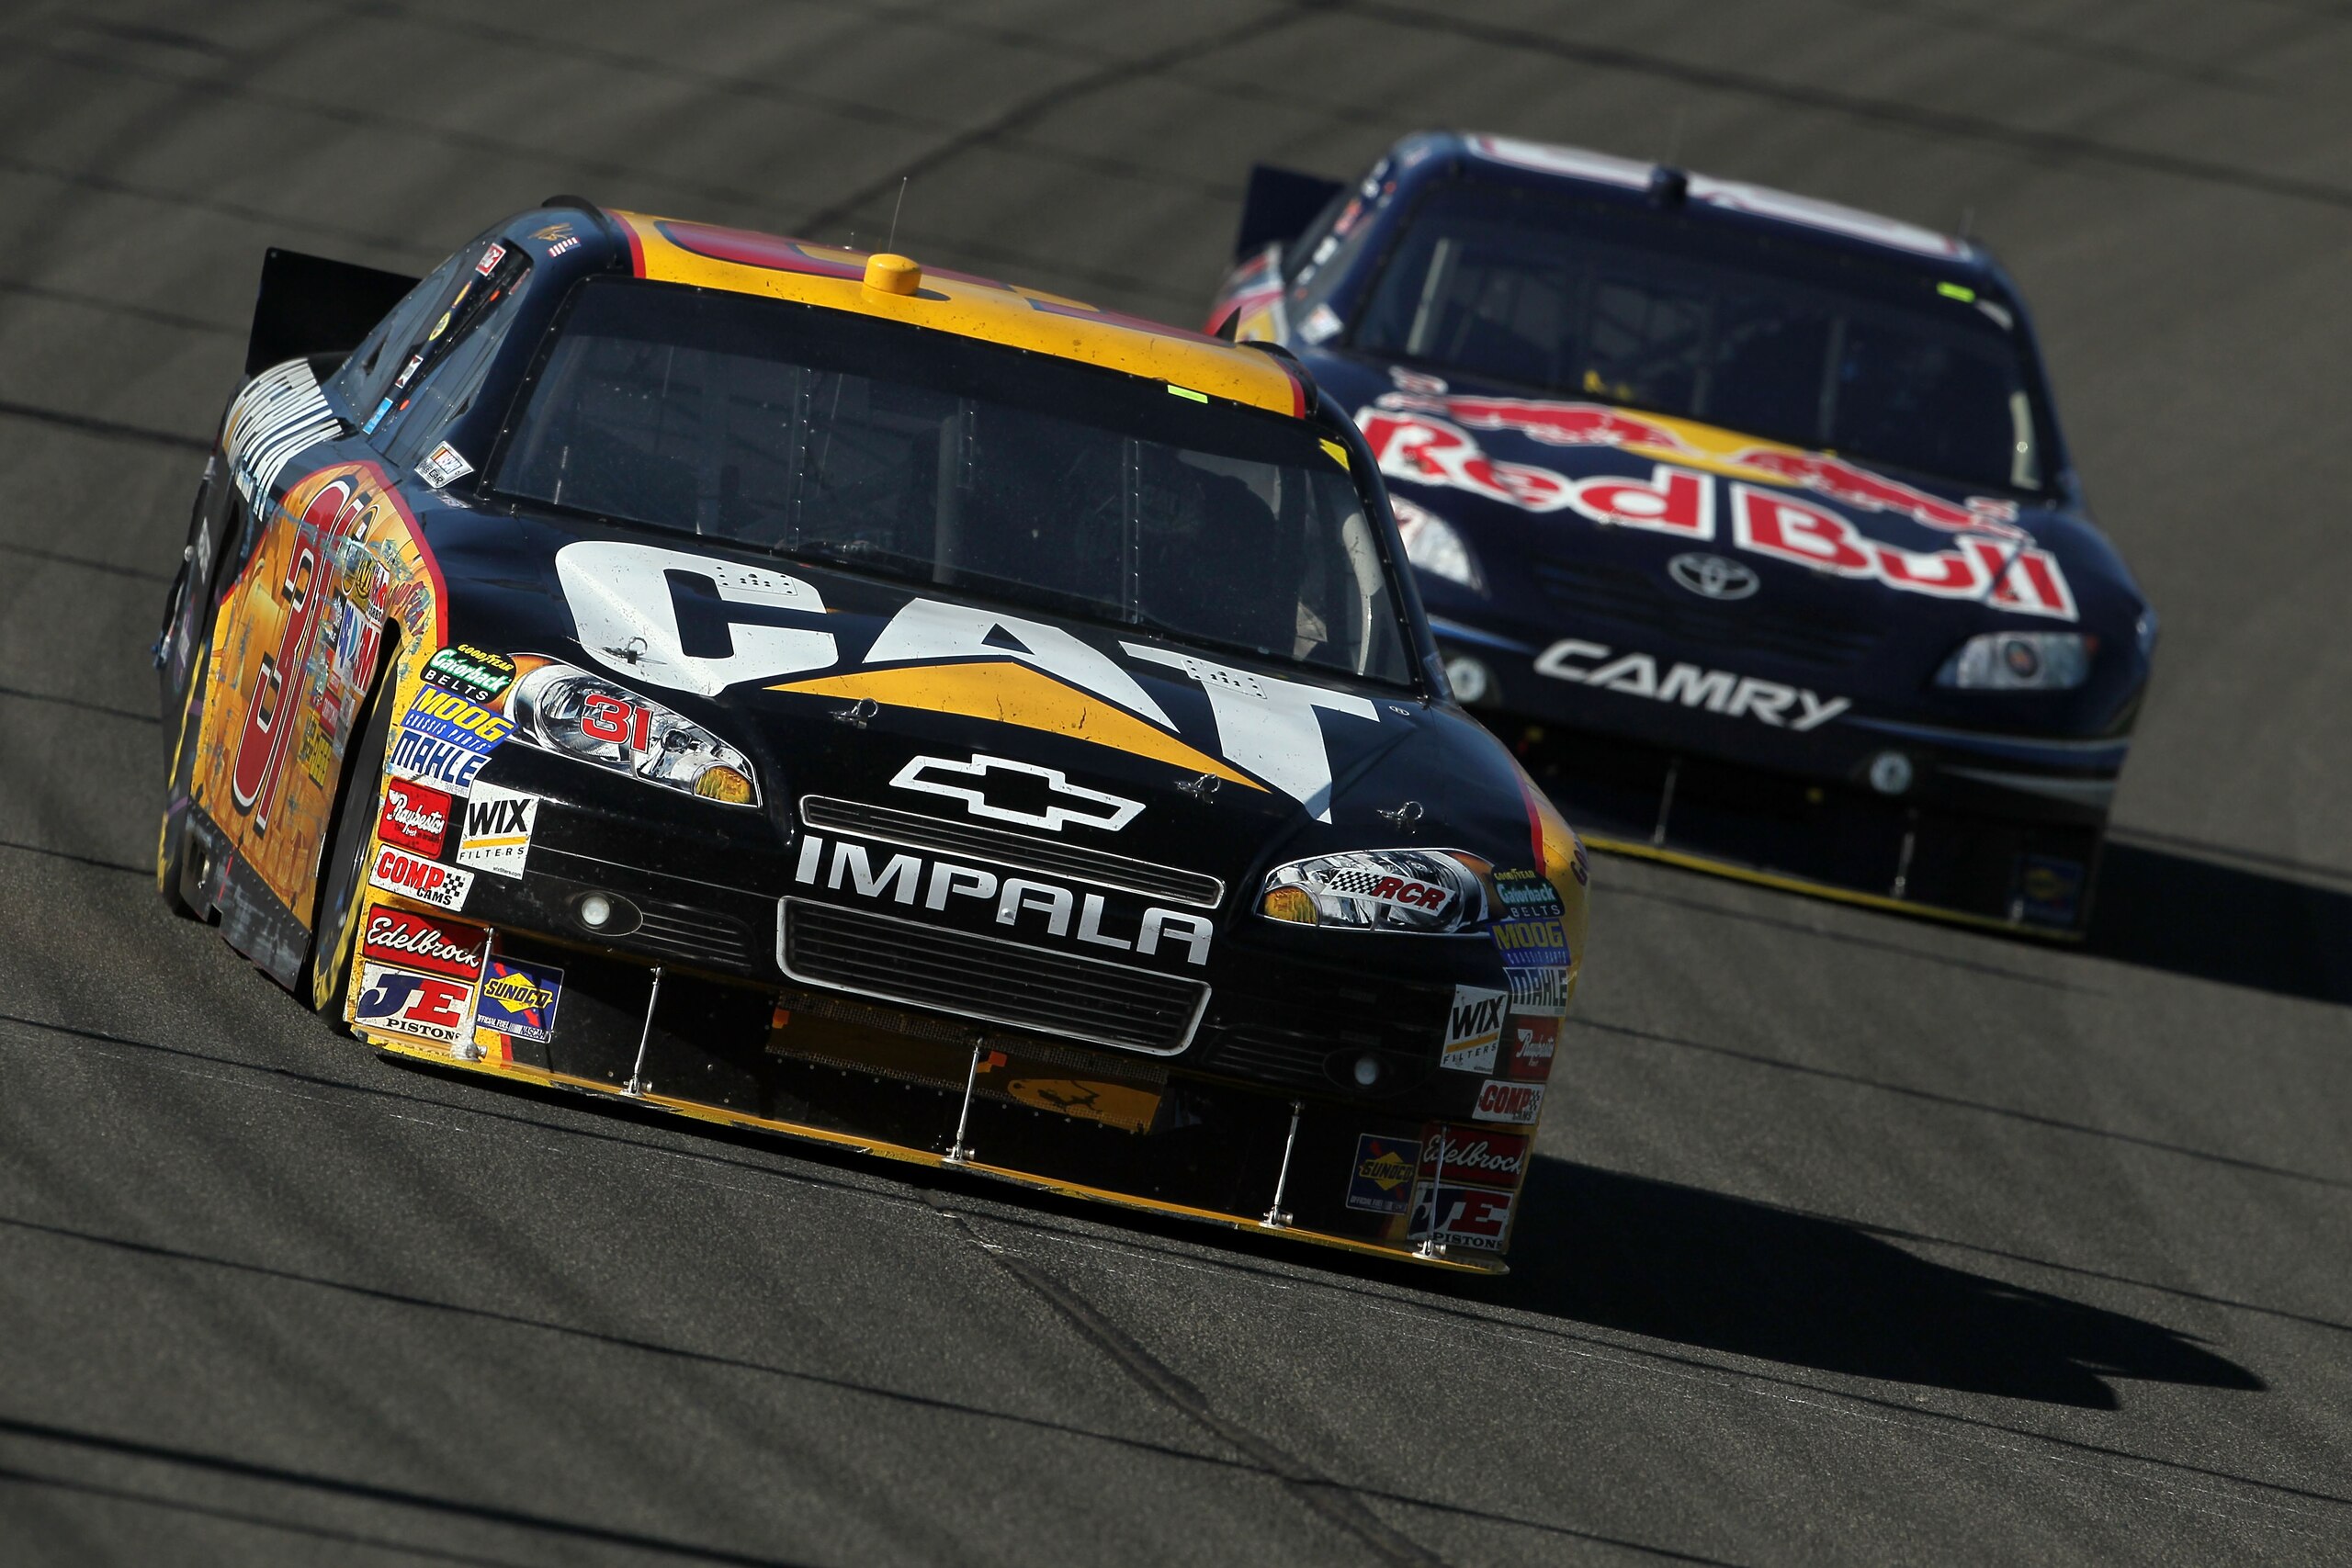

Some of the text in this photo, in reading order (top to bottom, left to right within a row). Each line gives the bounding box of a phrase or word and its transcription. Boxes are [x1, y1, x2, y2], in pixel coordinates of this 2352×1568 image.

[1353, 405, 2079, 623] Red Bull
[429, 649, 510, 693] Gatorback
[458, 644, 514, 671] GOODYEAR
[424, 670, 489, 700] BELTS
[555, 541, 1380, 824] CAT
[1533, 638, 1852, 731] CAMRY
[406, 714, 488, 750] CHASSIS PARTS
[415, 688, 514, 742] MOOG
[580, 693, 654, 754] 31
[390, 731, 489, 788] MAHLE
[469, 799, 531, 837] WIX
[377, 851, 446, 890] COMP
[459, 847, 525, 861] FILTERS
[416, 886, 453, 906] CAMS
[794, 834, 1214, 965] IMPALA
[1370, 875, 1447, 910] RCR
[1496, 883, 1556, 904] Gatorback
[1510, 904, 1561, 918] BELTS
[368, 917, 481, 968] Edelbrock
[1492, 921, 1564, 950] MOOG
[357, 973, 469, 1028] JE
[485, 981, 552, 1009] SUNOCO
[1508, 969, 1567, 1007] MAHLE
[496, 1019, 510, 1030] FUEL
[1453, 995, 1506, 1040] WIX
[1443, 1043, 1497, 1065] FILTERS
[1480, 1085, 1532, 1114] COMP
[1362, 1162, 1414, 1182] SUNOCO
[1423, 1134, 1525, 1175] Edelbrock
